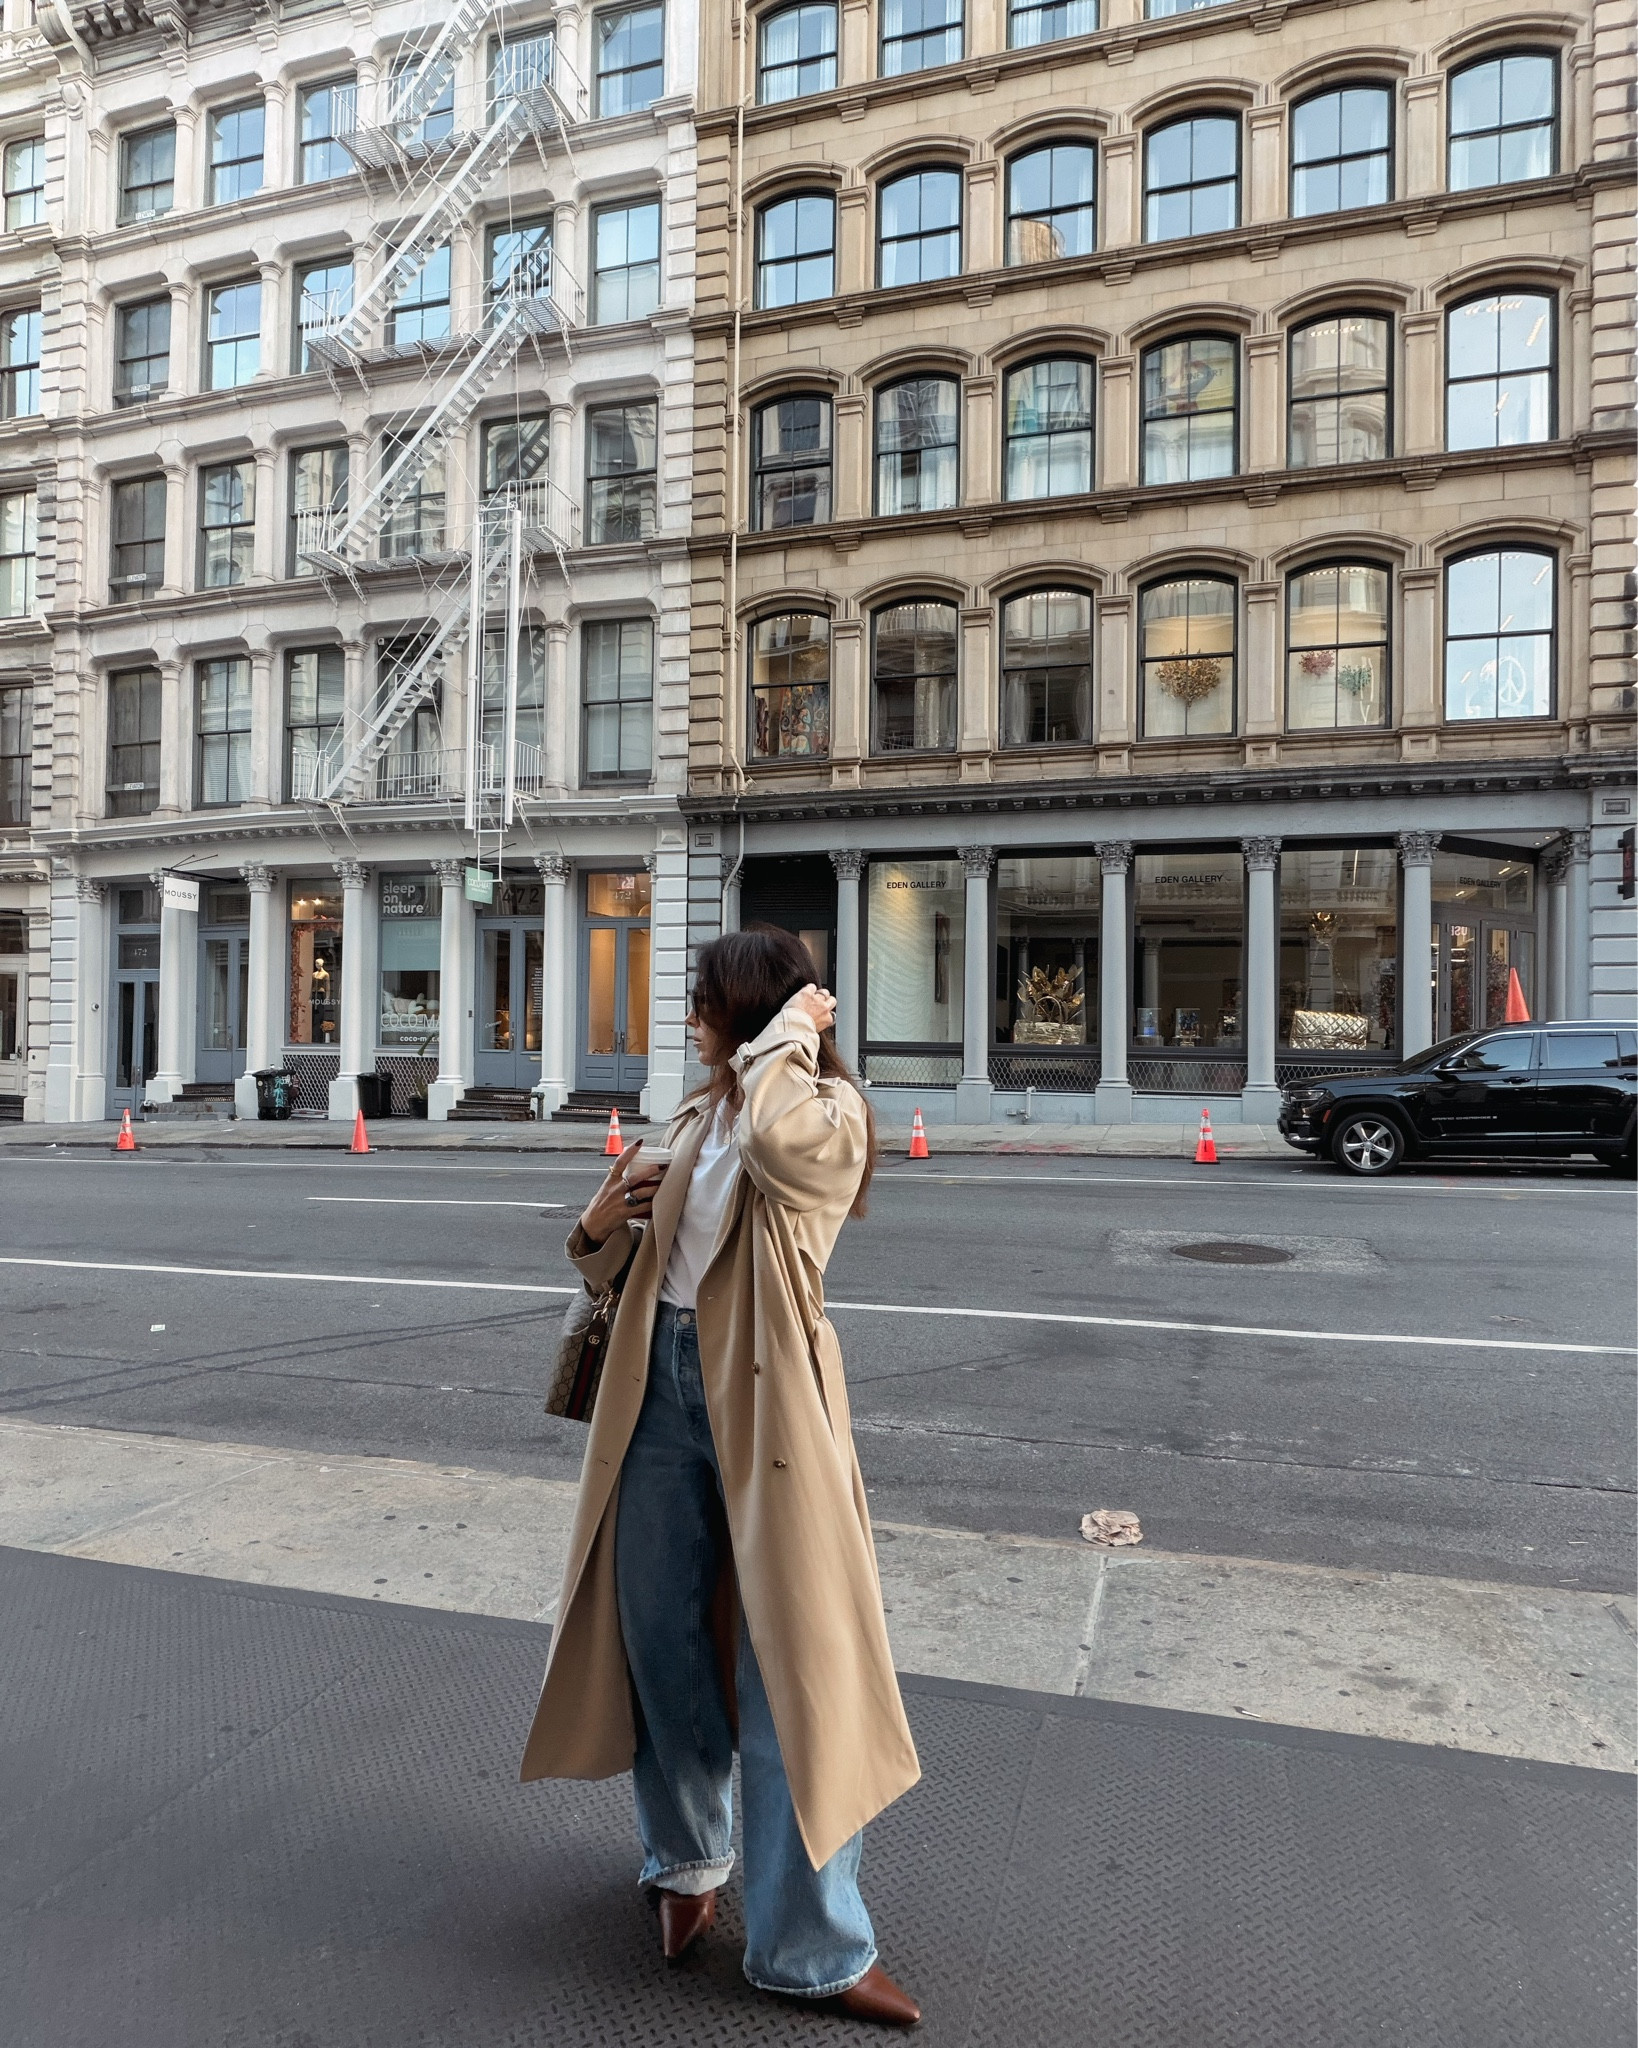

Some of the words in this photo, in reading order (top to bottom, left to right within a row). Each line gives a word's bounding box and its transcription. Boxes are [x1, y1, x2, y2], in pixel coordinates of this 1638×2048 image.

[1181, 875, 1223, 883] GALLERY
[1459, 876, 1475, 886] EDEN
[1476, 878, 1501, 888] GALLERY
[383, 880, 416, 898] sleep
[886, 881, 908, 889] EDEN
[910, 881, 947, 889] GALLERY
[164, 889, 197, 900] MOUSSY
[383, 894, 399, 904] on
[502, 887, 539, 903] 472
[383, 901, 424, 914] nature
[308, 998, 341, 1006] MOUSSY
